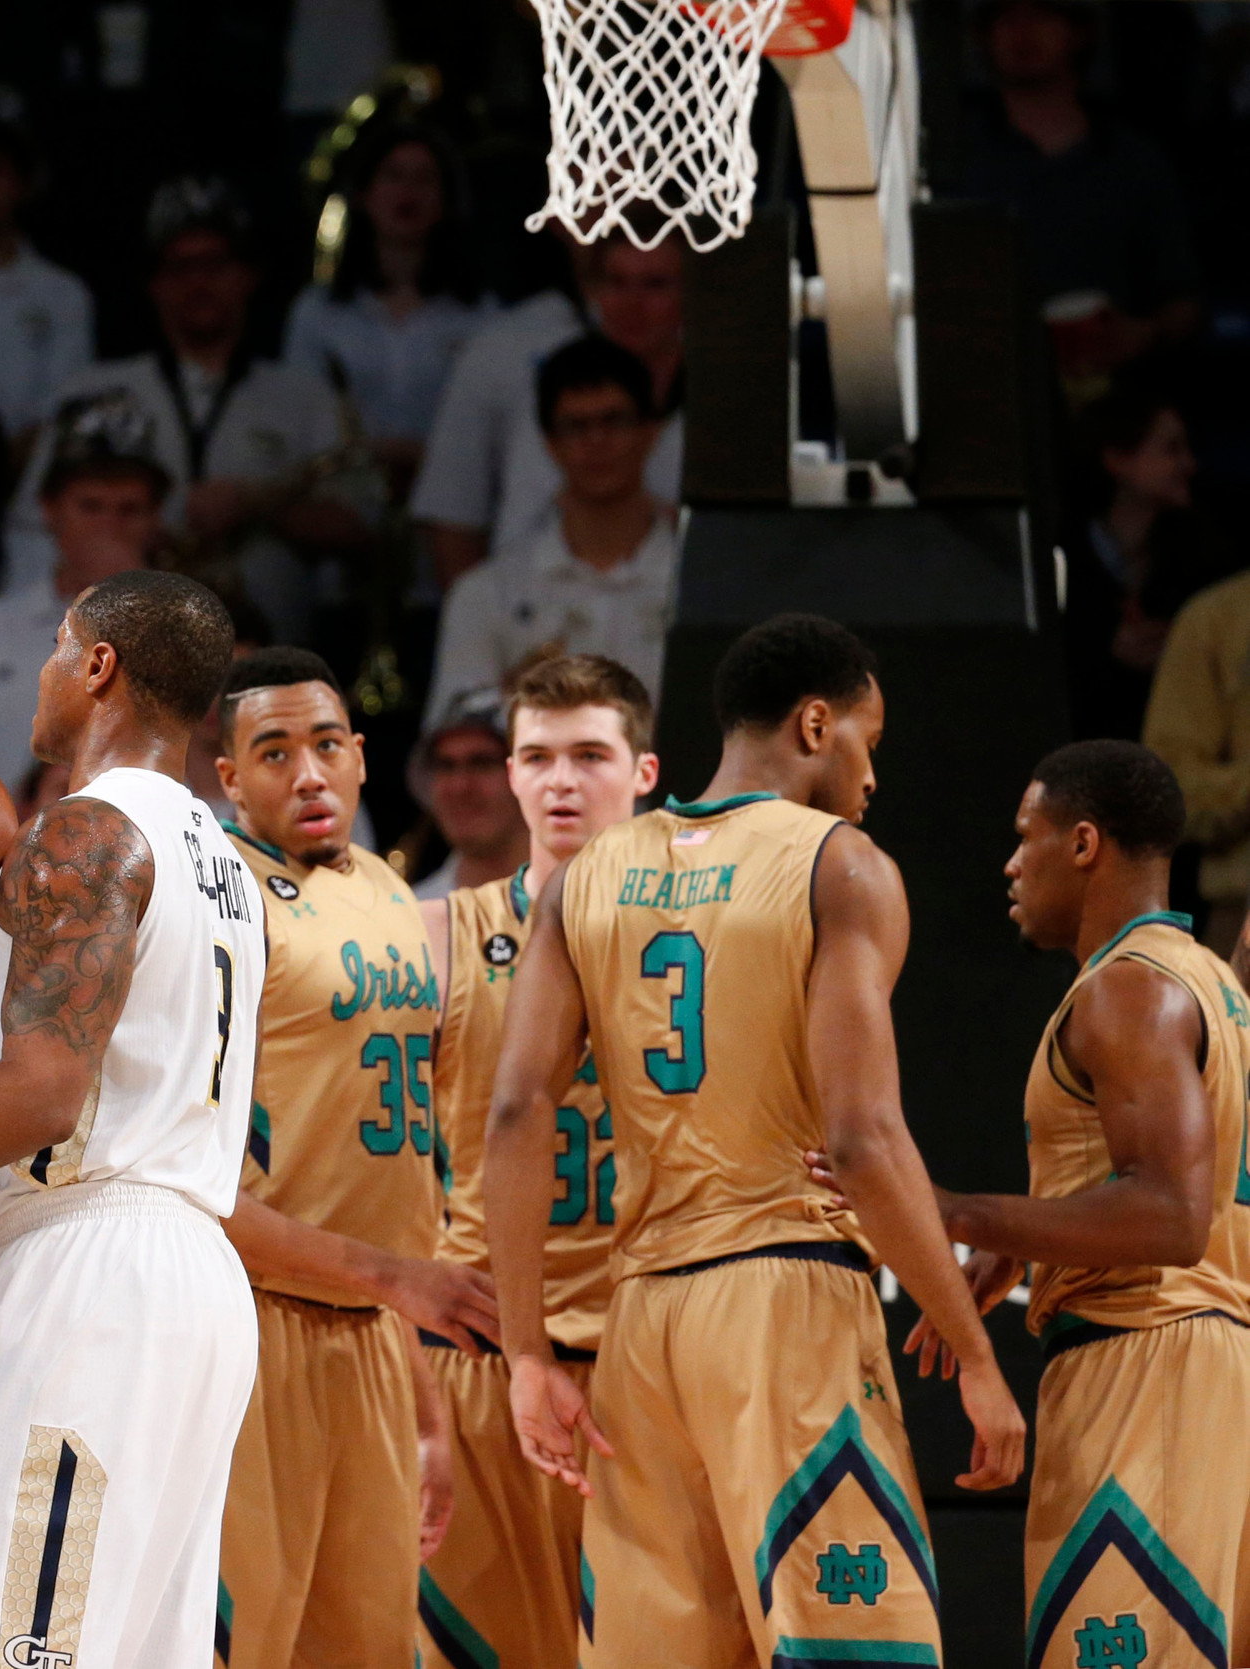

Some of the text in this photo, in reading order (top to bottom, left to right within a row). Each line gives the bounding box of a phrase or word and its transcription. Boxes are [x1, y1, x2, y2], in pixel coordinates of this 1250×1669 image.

[617, 865, 737, 911] BEACHEM
[331, 939, 440, 1021] Irish
[641, 930, 707, 1096] 3
[359, 1033, 431, 1156] 35
